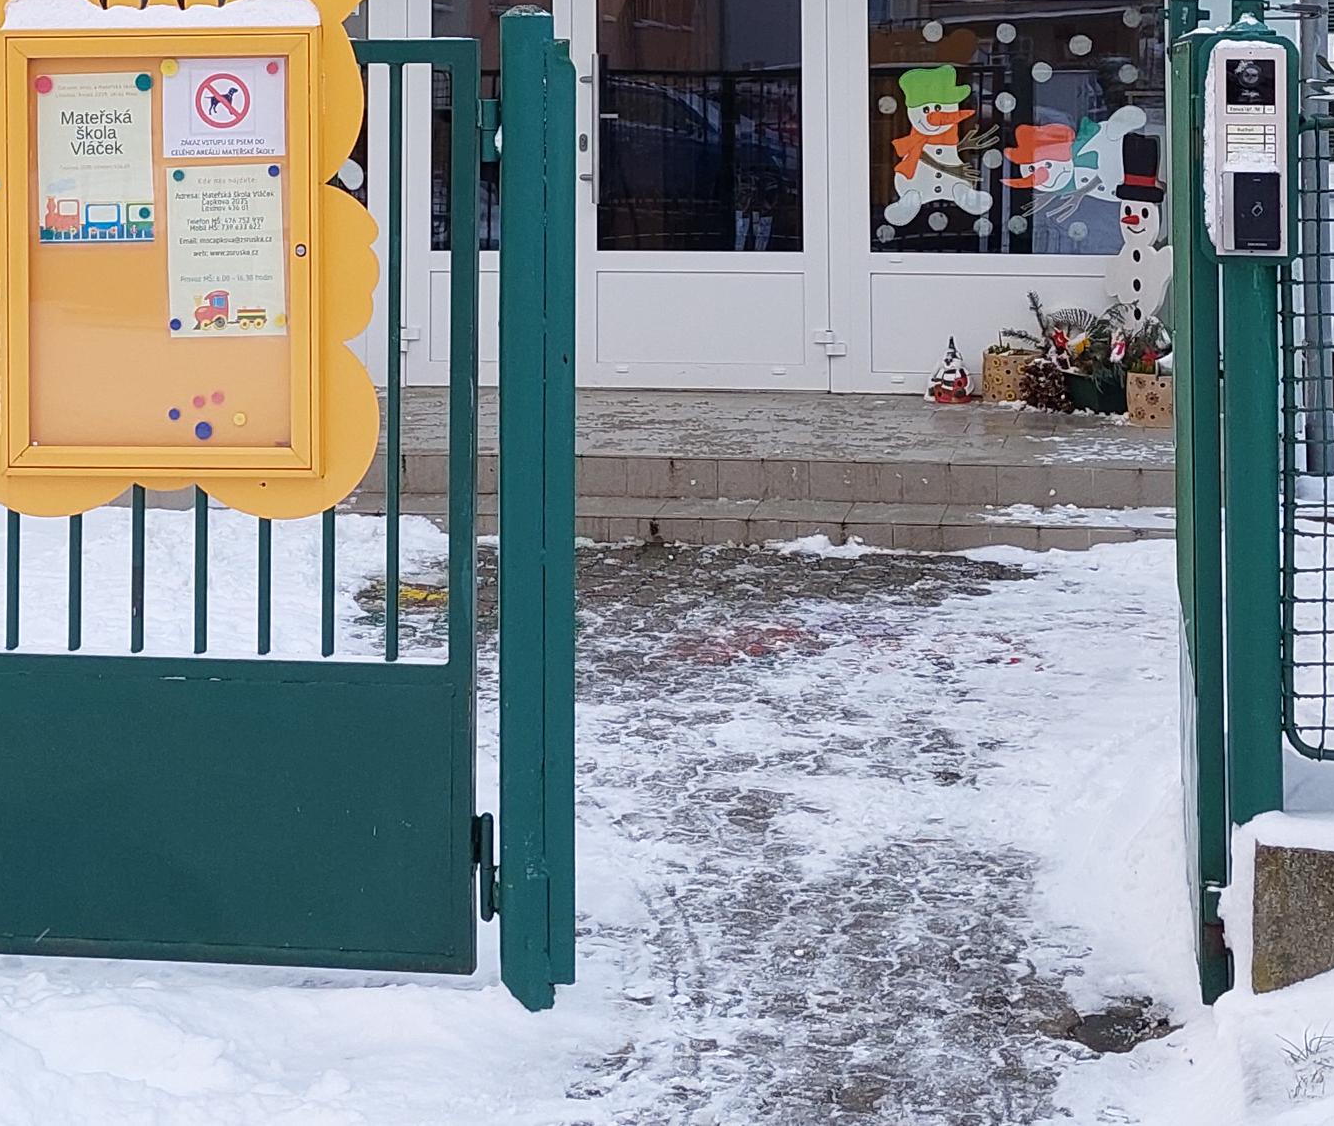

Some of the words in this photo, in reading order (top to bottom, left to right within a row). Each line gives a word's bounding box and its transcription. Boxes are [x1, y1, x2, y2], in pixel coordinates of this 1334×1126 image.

[61, 109, 132, 125] Mateřská
[76, 125, 117, 140] škola
[70, 140, 123, 155] Vláček
[180, 138, 200, 146] ZÁKAZ
[201, 138, 226, 146] VSTUPU
[171, 148, 195, 156] CELÉHO
[196, 148, 220, 156] AREÁLU
[221, 147, 255, 155] MATEŘSKÉ
[255, 147, 275, 155] ŠKOLY
